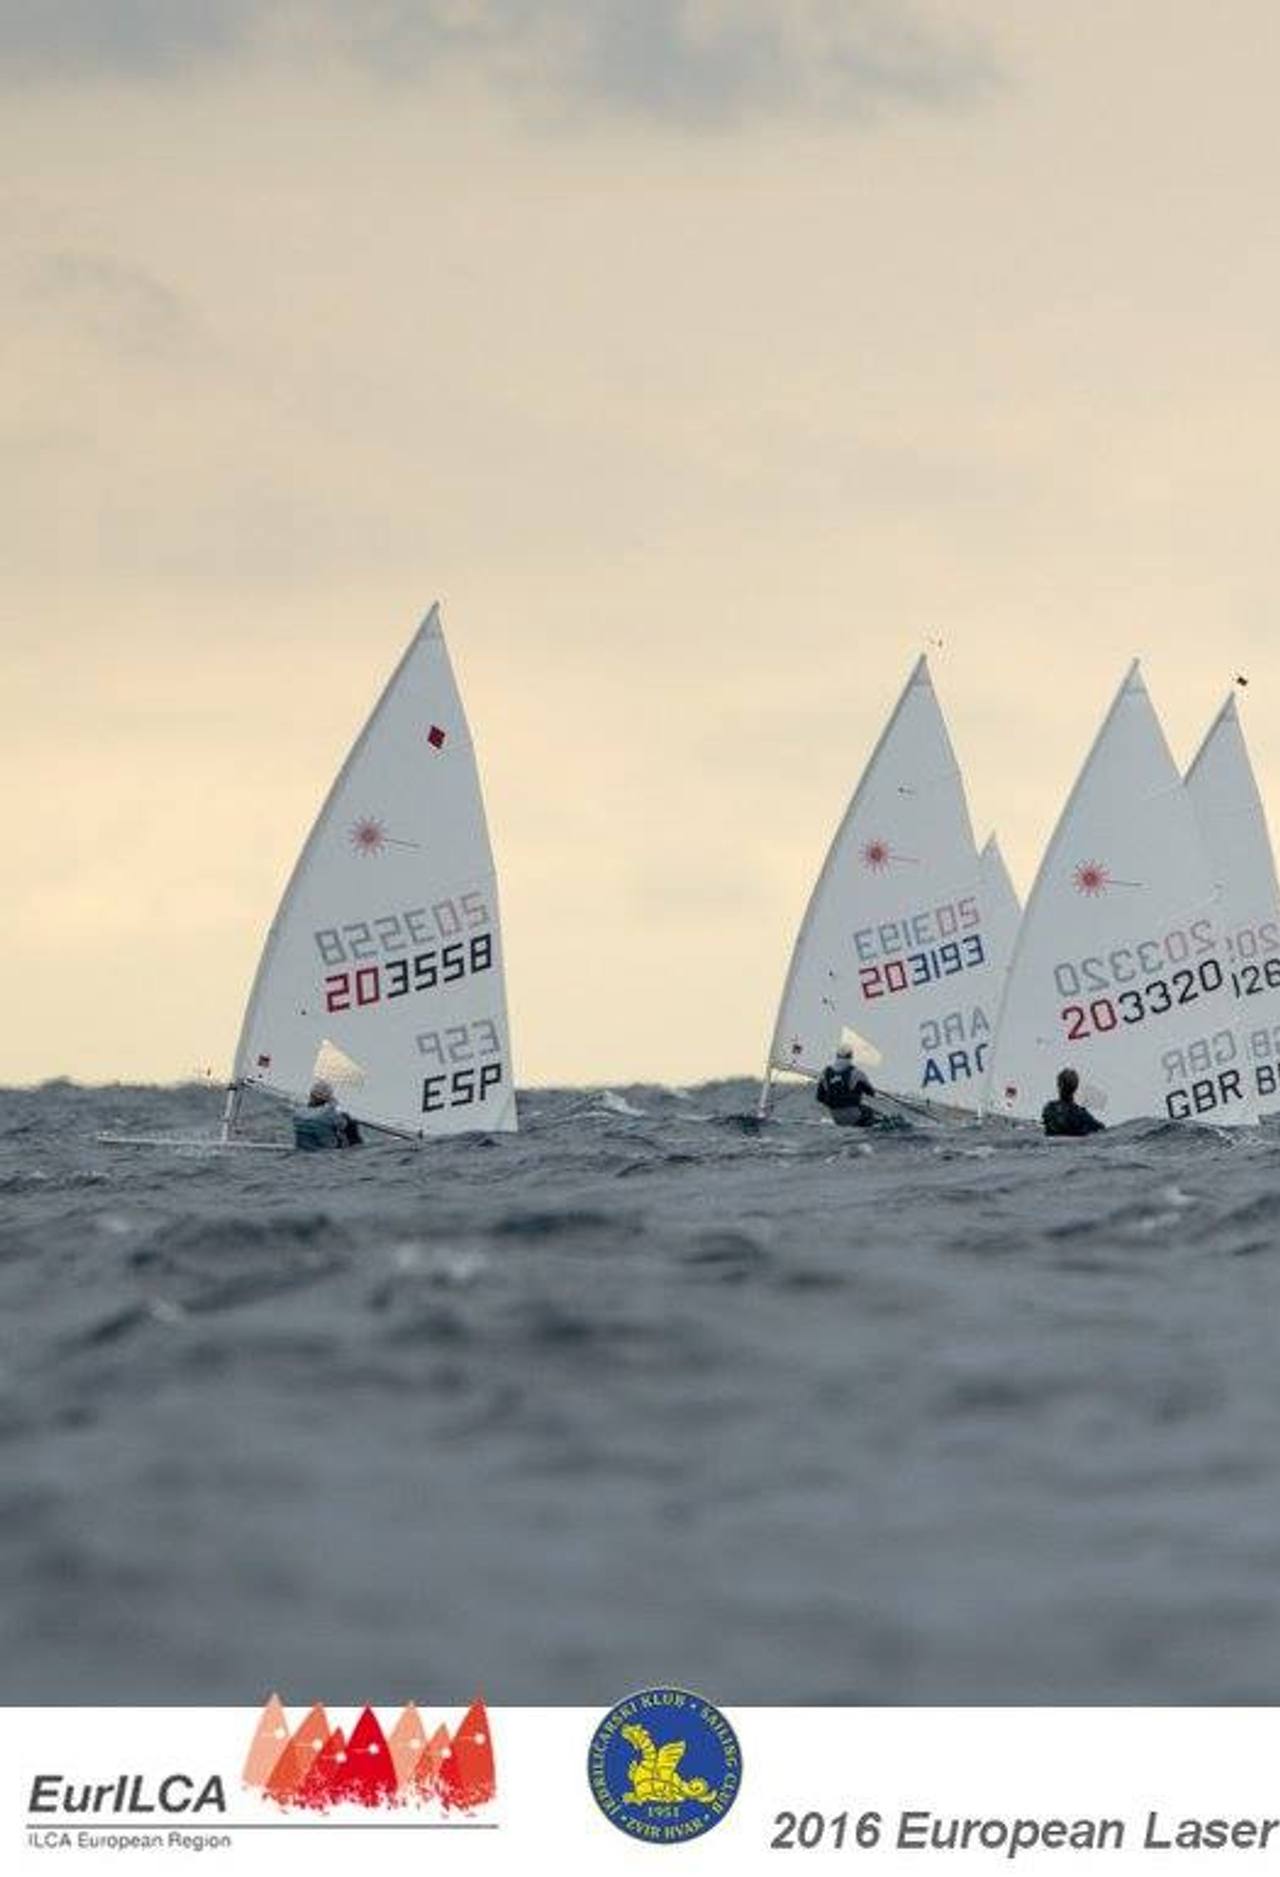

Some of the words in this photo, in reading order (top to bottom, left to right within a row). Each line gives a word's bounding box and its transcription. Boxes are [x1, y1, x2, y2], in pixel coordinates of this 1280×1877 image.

[325, 933, 492, 1013] 203558
[859, 934, 985, 999] 203193
[1061, 960, 1222, 1040] 203320
[421, 1063, 501, 1112] ESP
[1166, 1069, 1243, 1120] GBR
